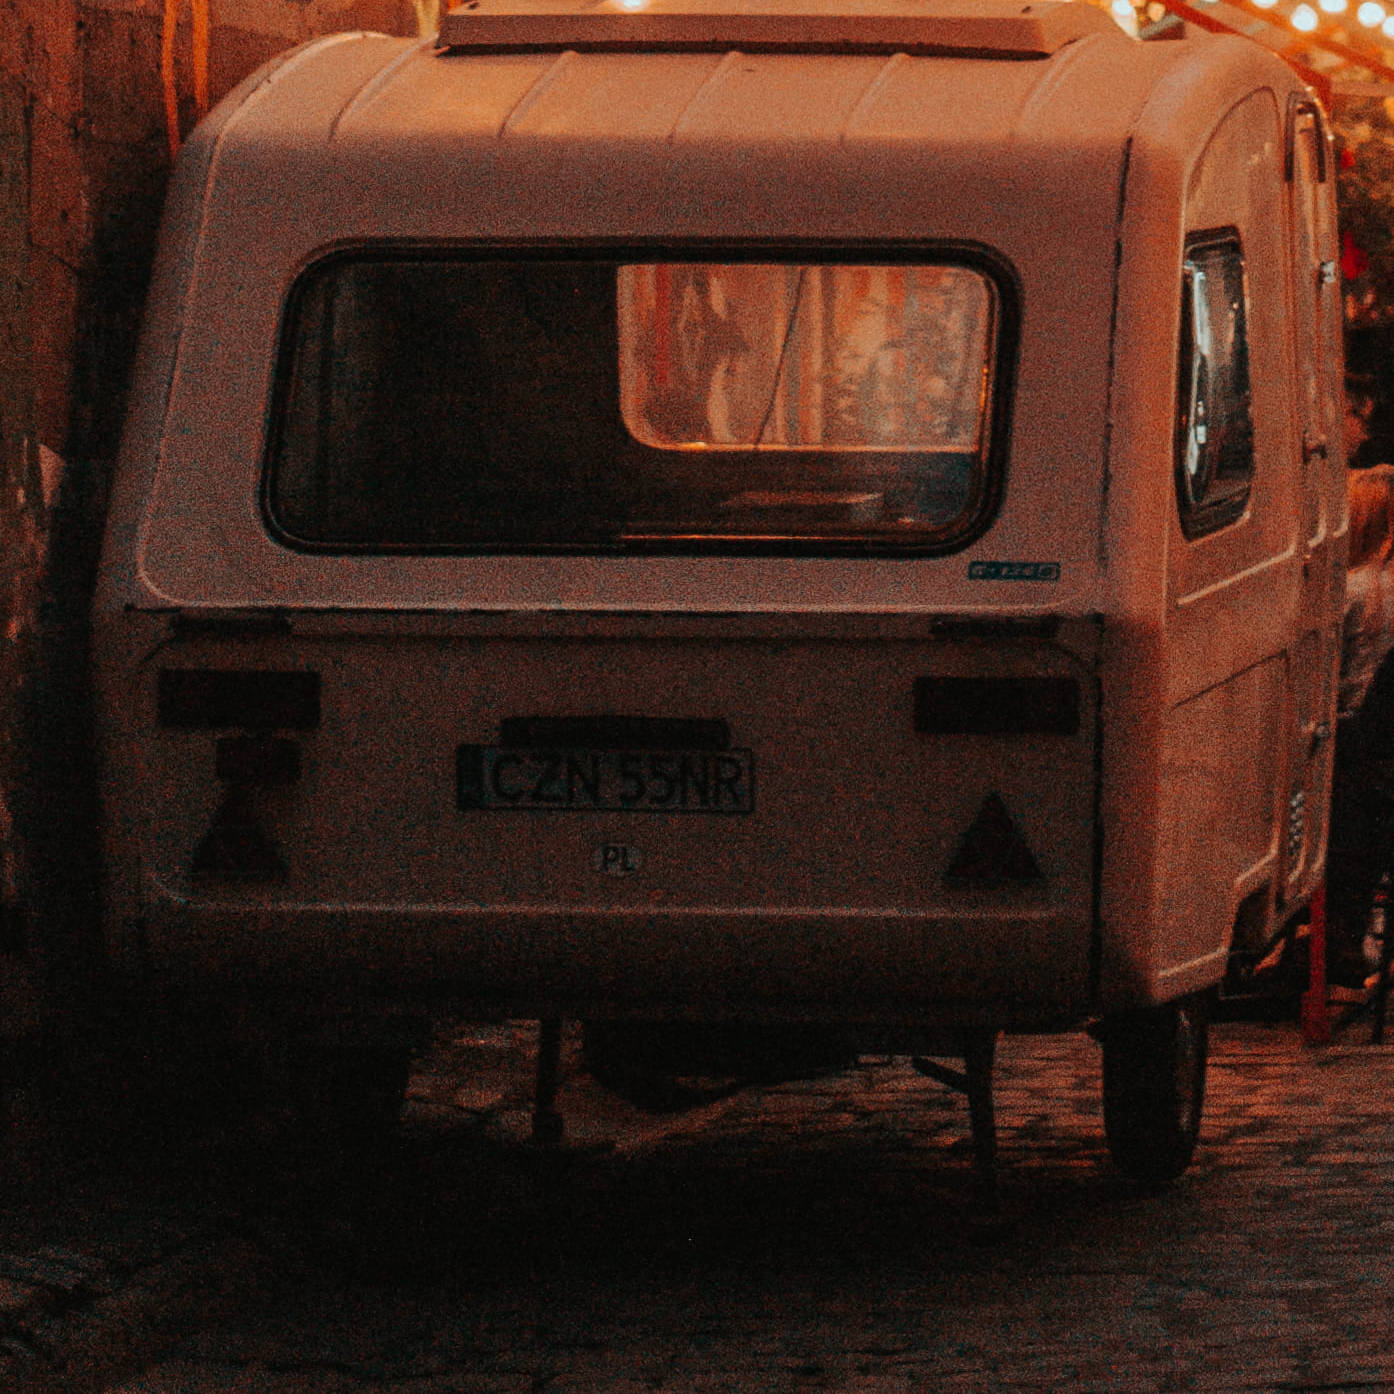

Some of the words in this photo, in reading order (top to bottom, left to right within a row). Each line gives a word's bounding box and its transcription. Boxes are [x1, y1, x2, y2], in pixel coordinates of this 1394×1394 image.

[491, 753, 601, 804] CZN
[618, 754, 743, 805] 55NR
[601, 845, 635, 872] PL
